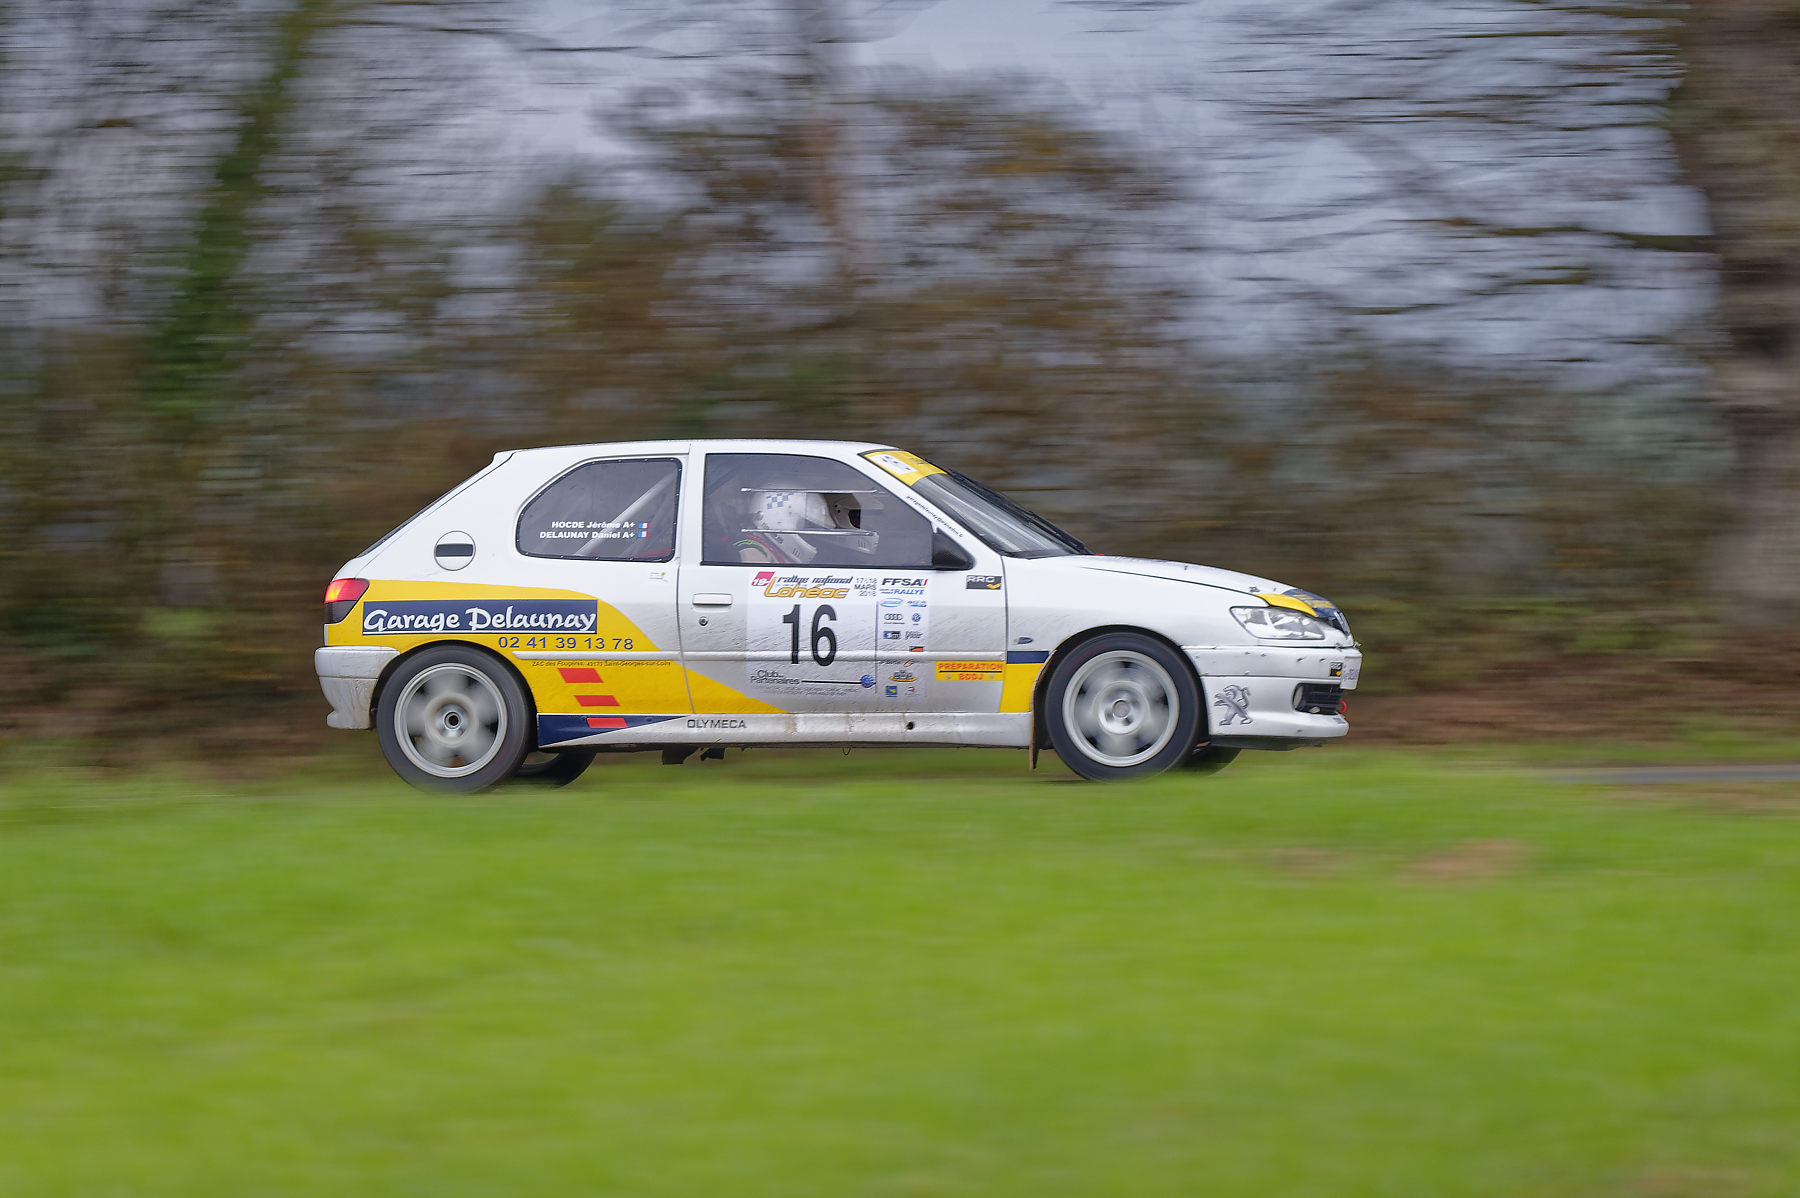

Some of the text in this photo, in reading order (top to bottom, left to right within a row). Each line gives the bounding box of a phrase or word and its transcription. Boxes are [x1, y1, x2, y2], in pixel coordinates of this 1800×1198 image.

[586, 520, 621, 528] Jérôme
[777, 575, 854, 585] rallye national
[881, 578, 922, 586] FFSA
[764, 576, 850, 598] Lohéac
[363, 605, 596, 632] Garage Delaunay
[782, 603, 837, 666] 16
[498, 636, 634, 650] 02 41 39 13 78
[757, 669, 779, 677] Club
[750, 676, 800, 685] Partenaires
[687, 719, 747, 729] OLYMECA
